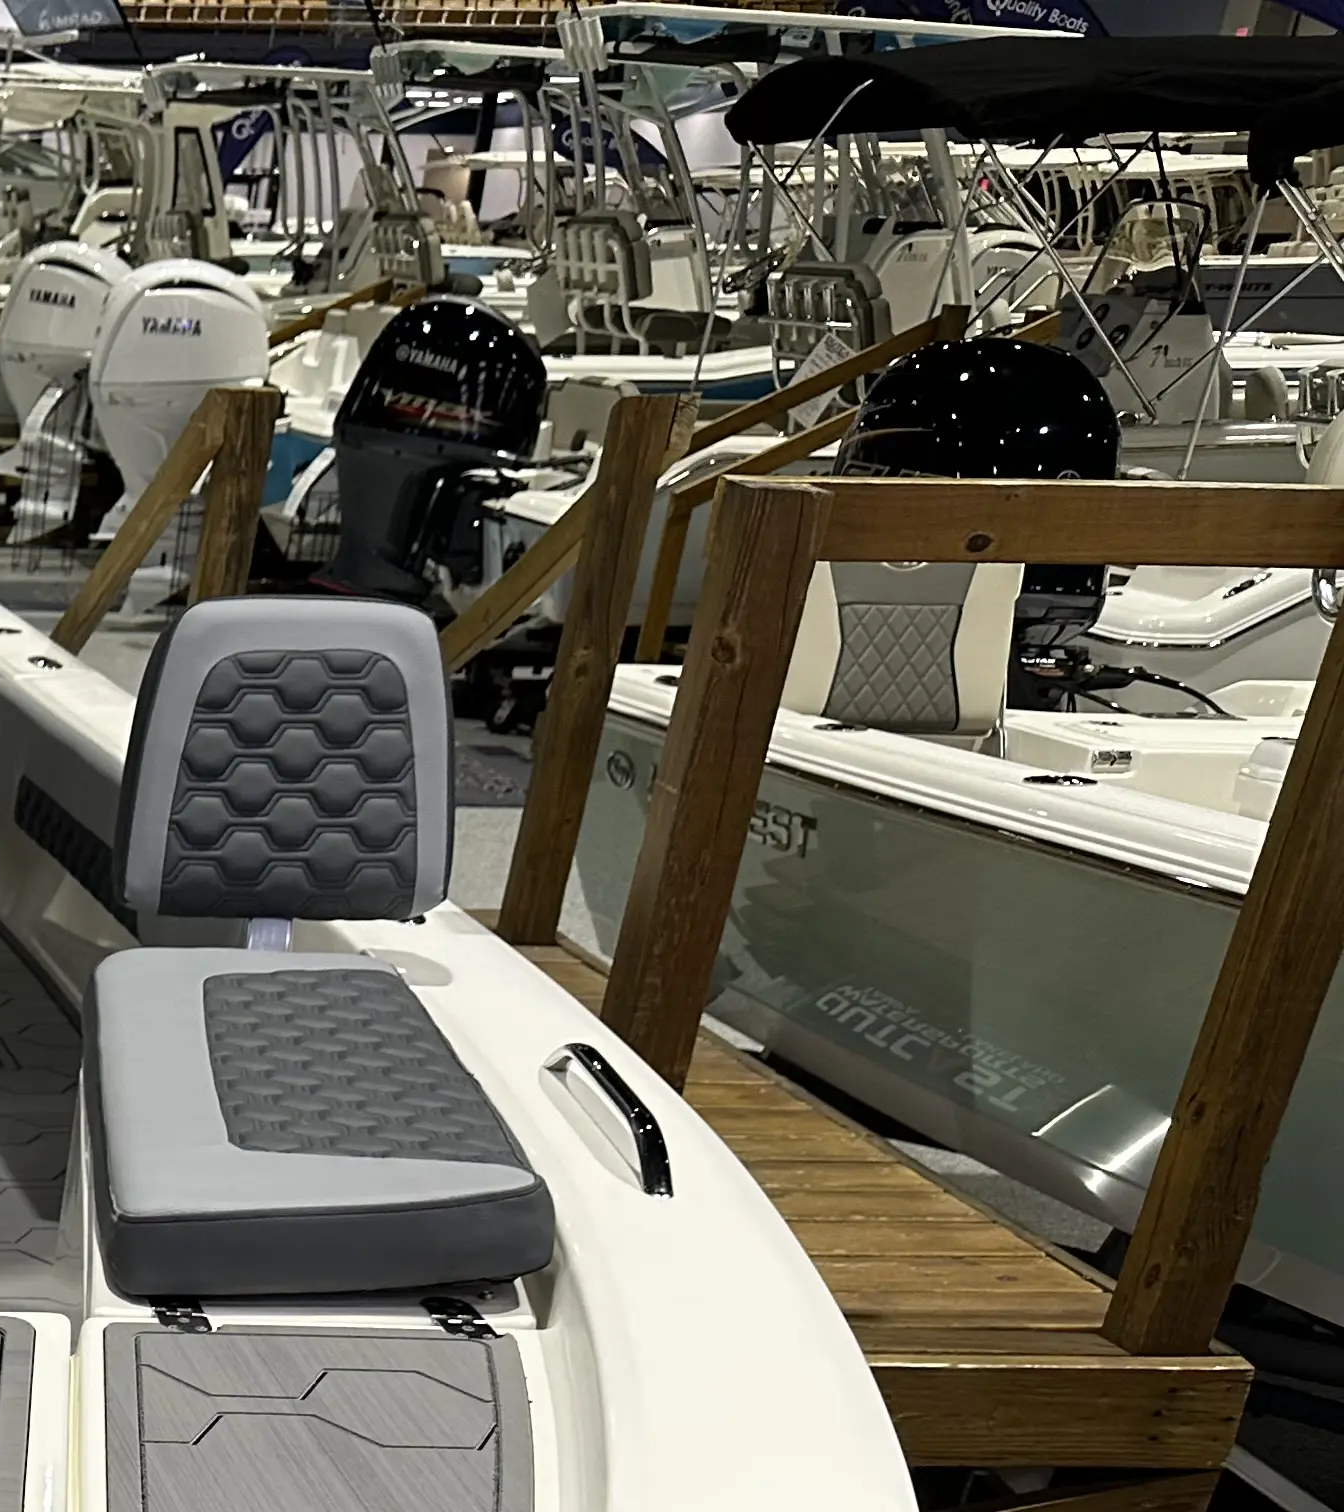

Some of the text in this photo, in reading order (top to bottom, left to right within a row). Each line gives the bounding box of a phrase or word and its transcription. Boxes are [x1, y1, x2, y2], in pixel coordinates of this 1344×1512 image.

[1048, 8, 1090, 33] Boats
[29, 288, 76, 308] YAMAHA
[142, 316, 202, 336] YAMAHA
[408, 346, 459, 375] YAMAHA
